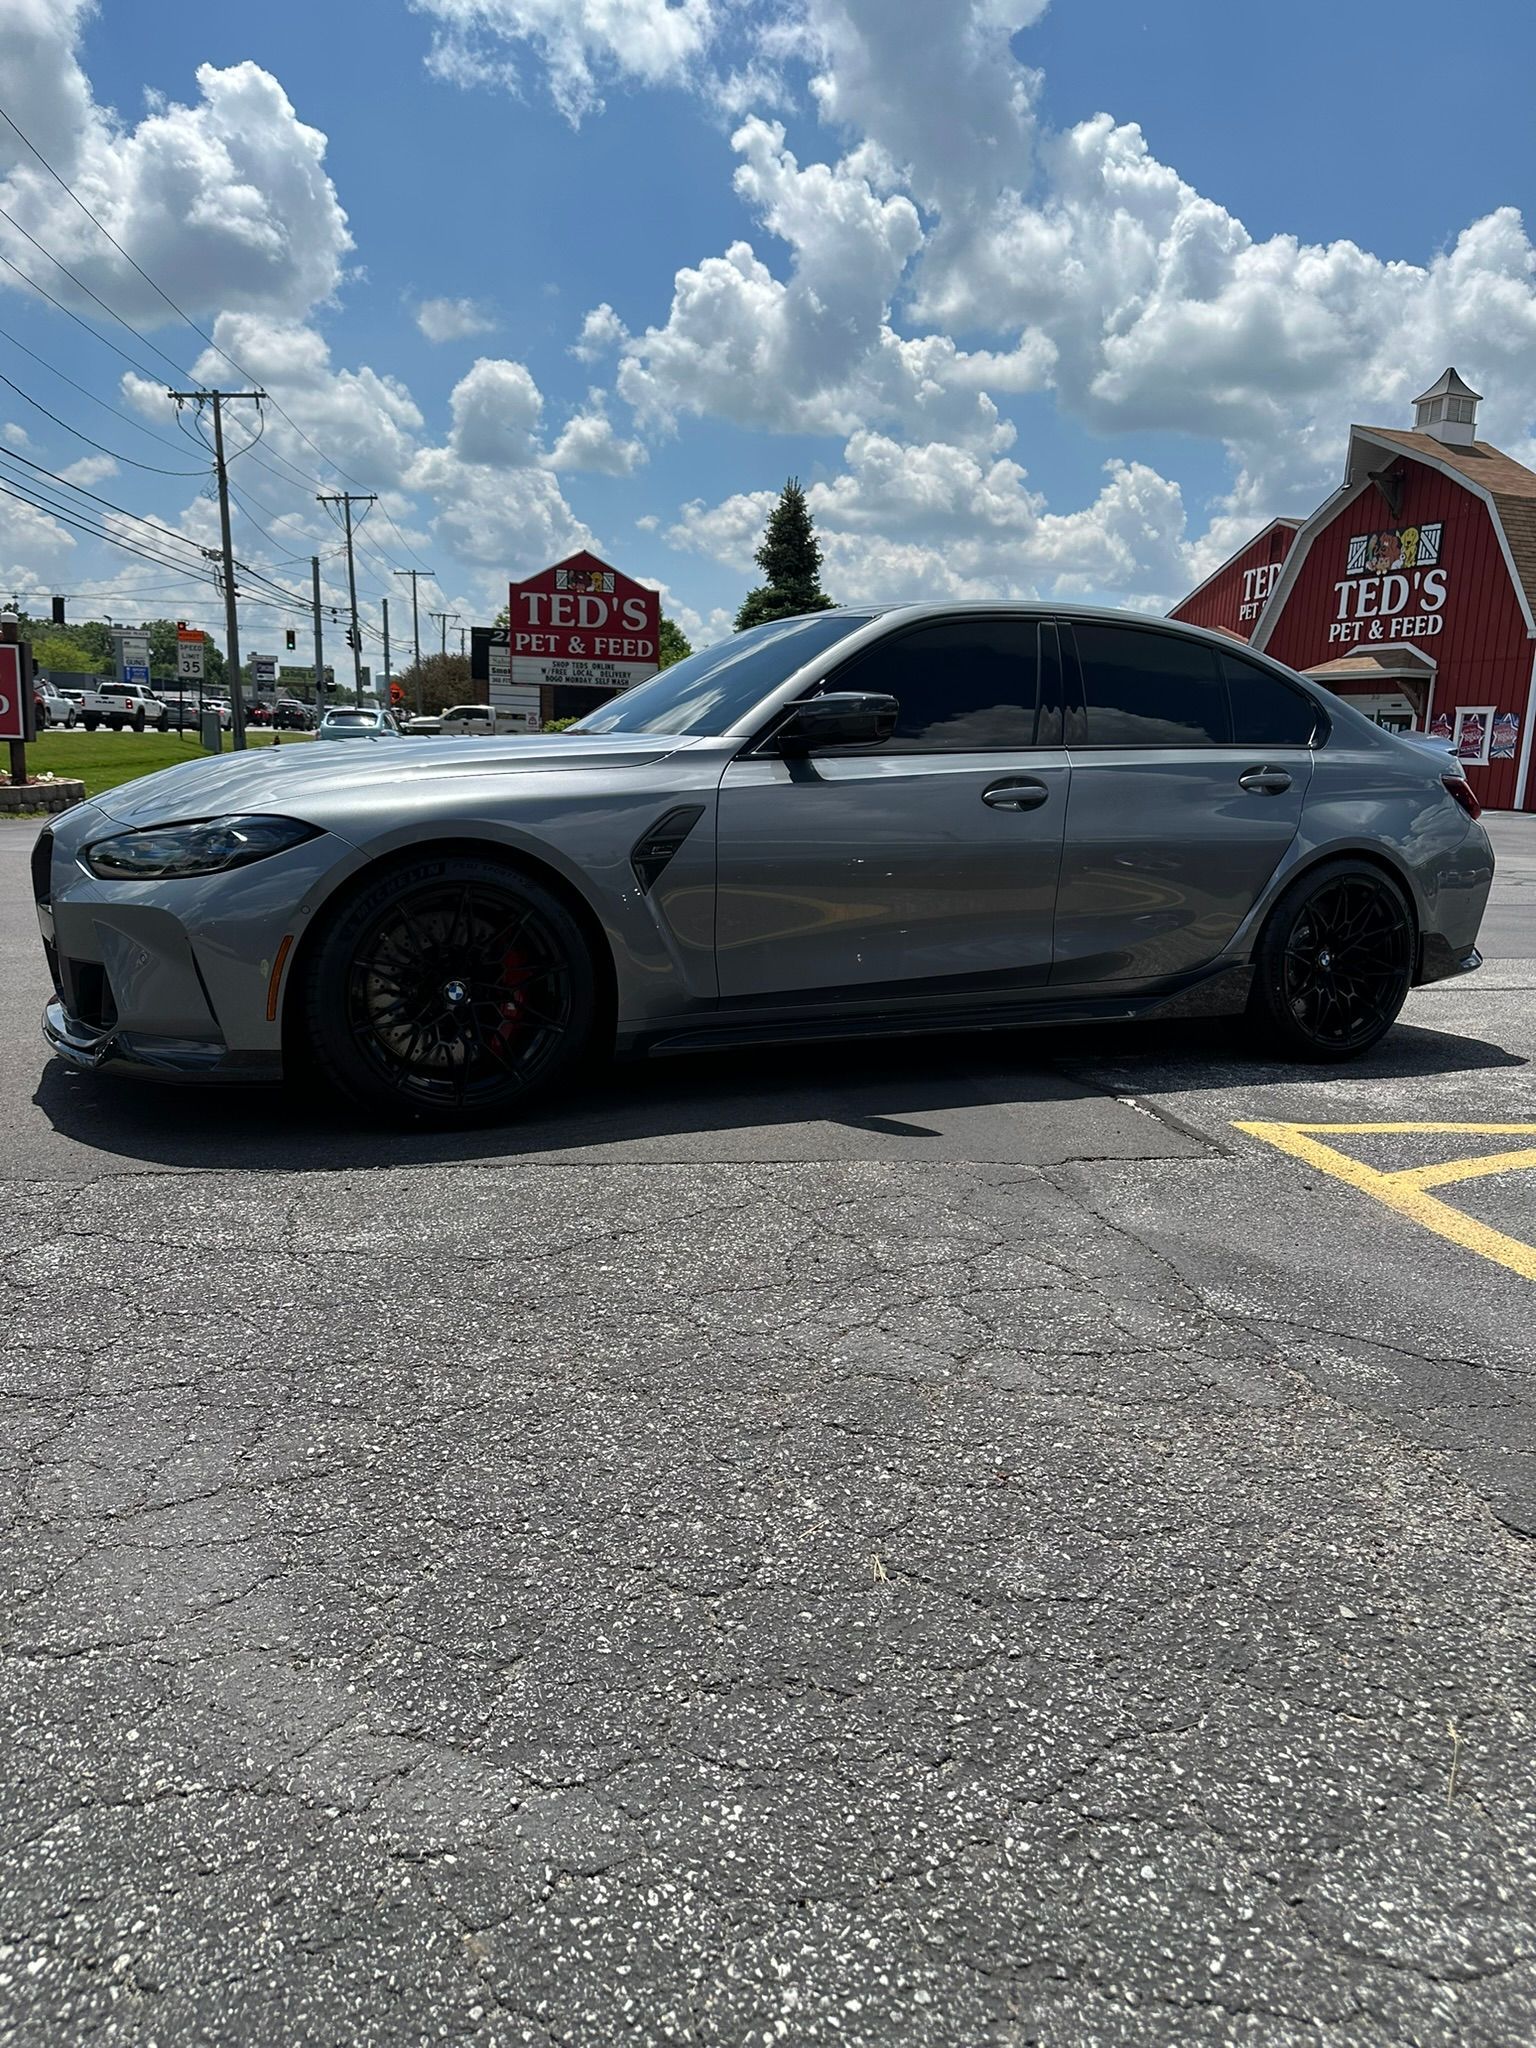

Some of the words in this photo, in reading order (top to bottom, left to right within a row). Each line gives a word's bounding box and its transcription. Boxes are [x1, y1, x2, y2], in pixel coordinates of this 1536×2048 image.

[1334, 569, 1447, 619] TED'S
[520, 592, 648, 631] TED'S
[1239, 602, 1259, 621] PET
[1328, 621, 1364, 643] PET
[1368, 619, 1384, 640] &
[1389, 614, 1443, 638] FEED
[515, 633, 560, 652] PET
[568, 636, 586, 654] &
[594, 637, 654, 657] FEED
[182, 661, 200, 673] 35
[573, 669, 593, 677] LOCAL
[565, 676, 592, 684] MONDAY
[595, 677, 610, 685] SELF
[354, 864, 441, 920] MICHELIN
